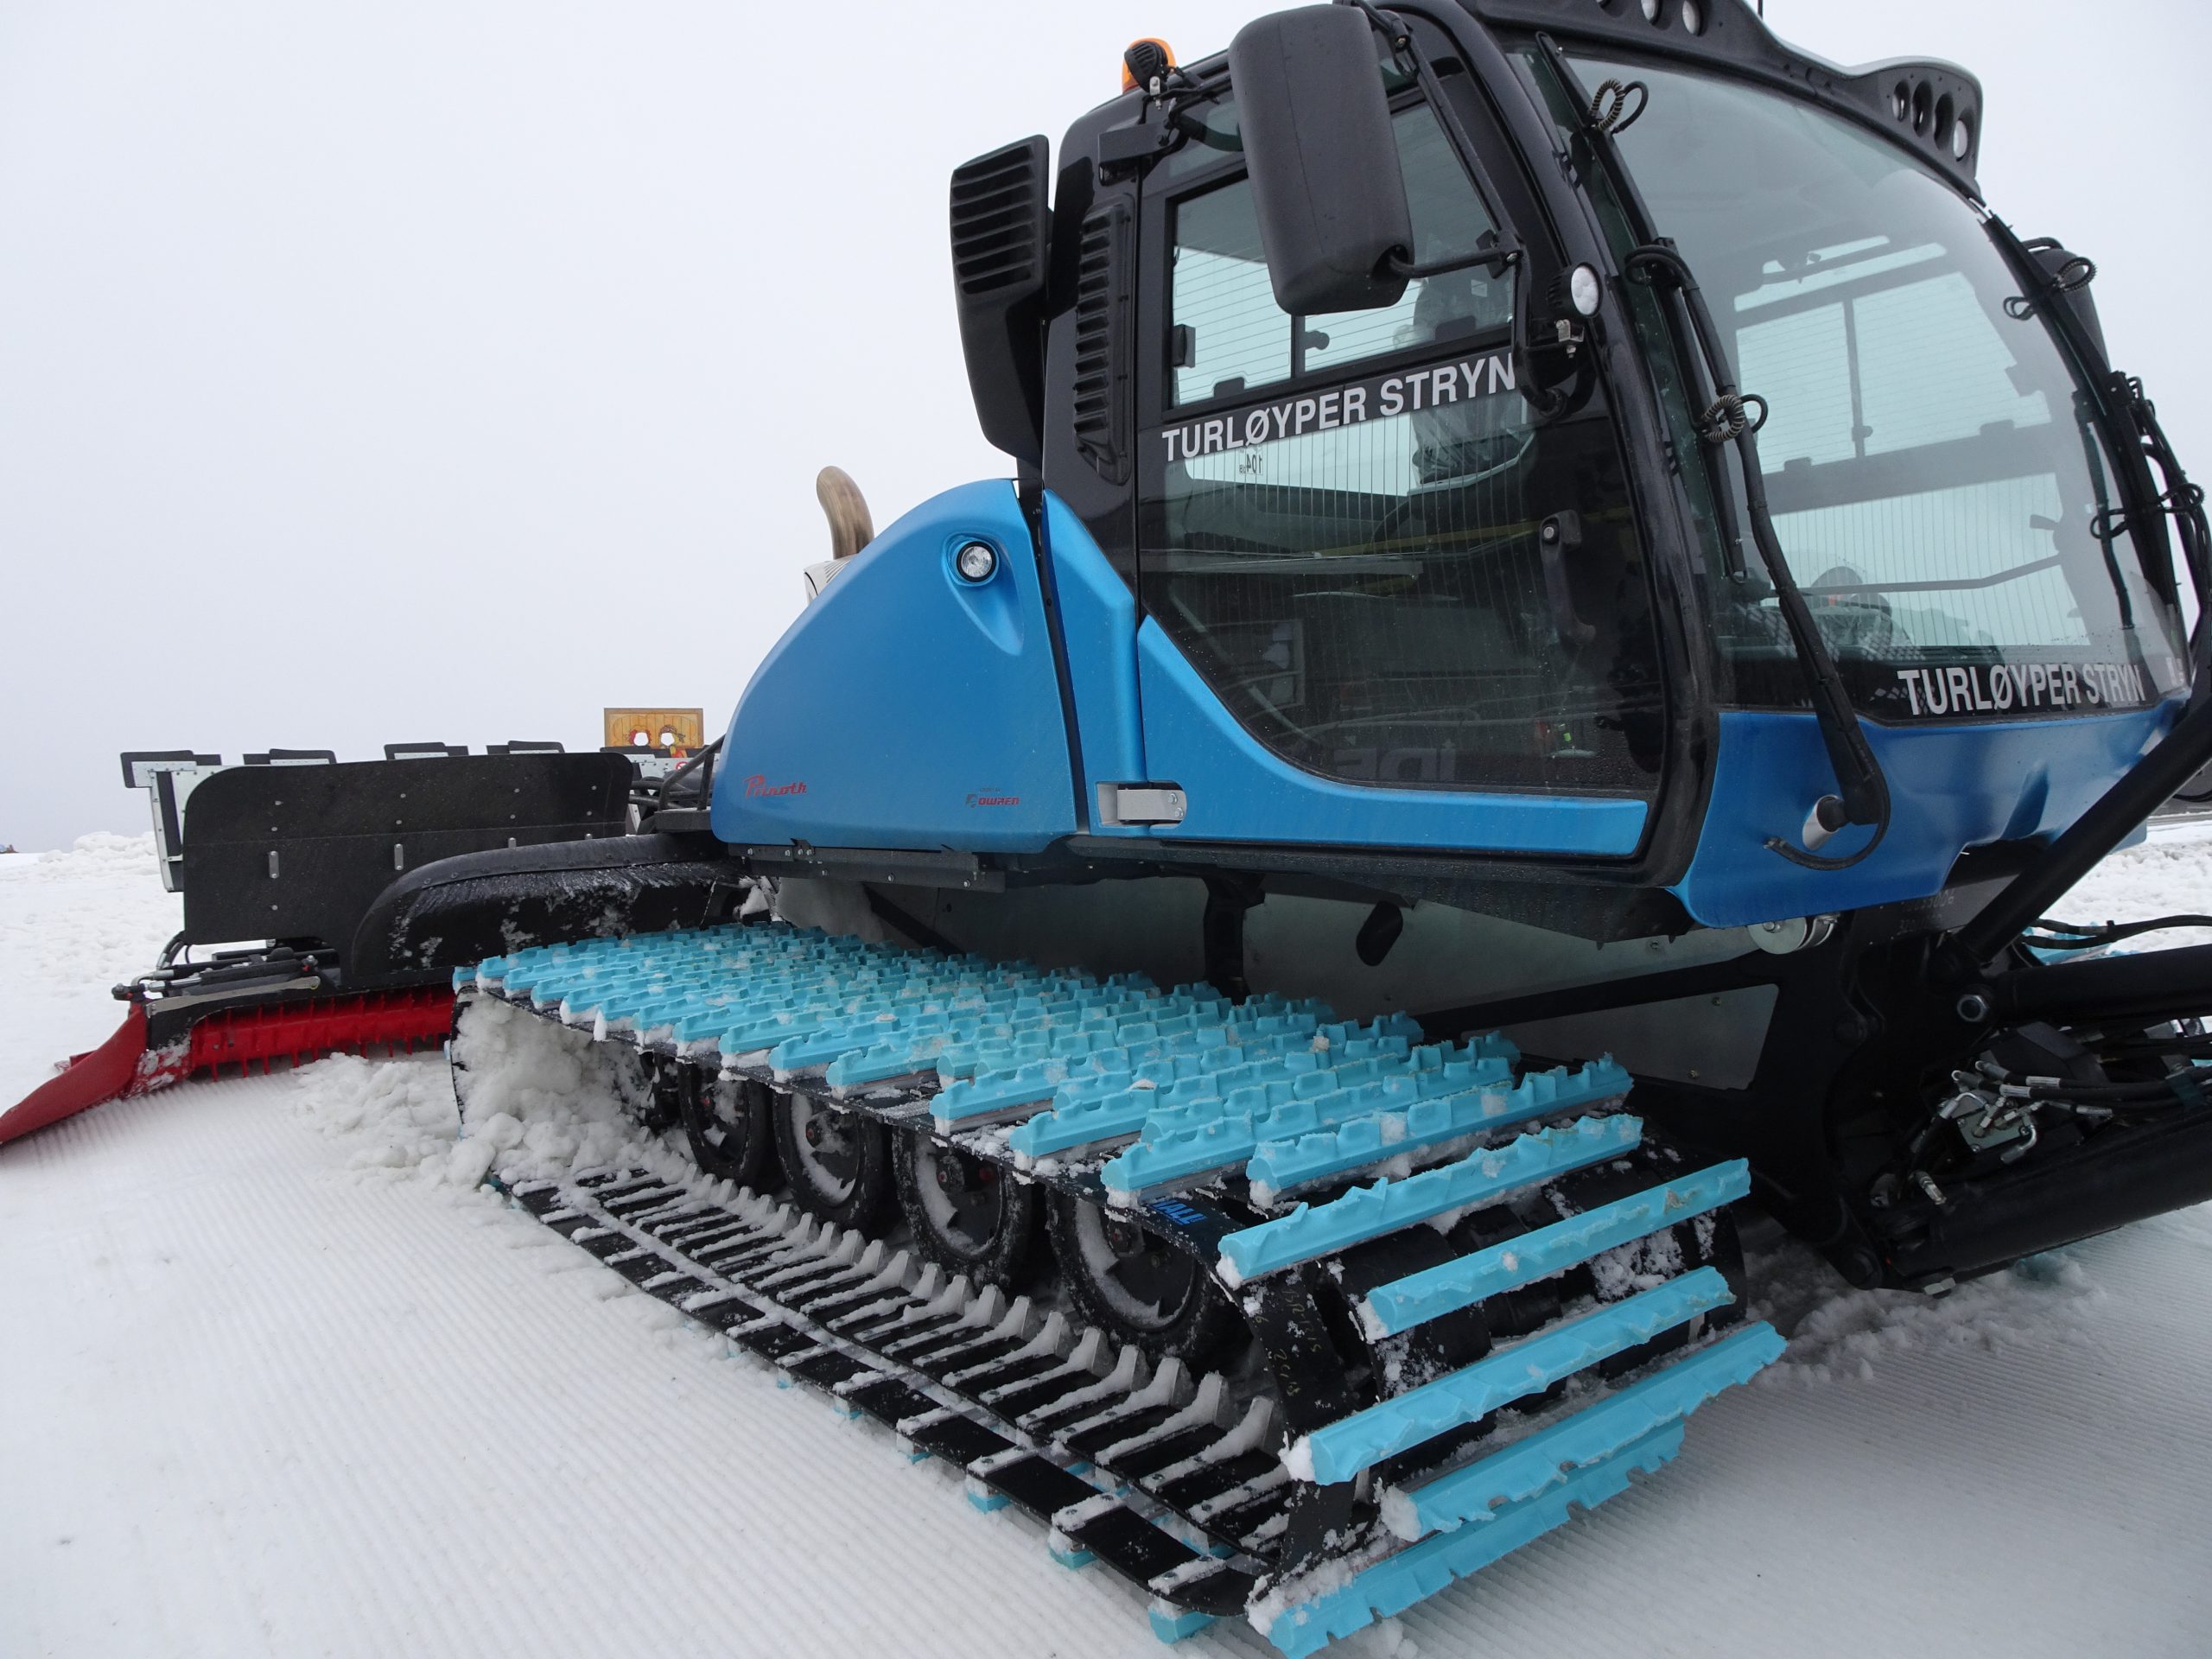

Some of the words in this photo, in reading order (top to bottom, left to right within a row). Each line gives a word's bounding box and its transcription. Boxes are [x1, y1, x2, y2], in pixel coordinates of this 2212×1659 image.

[1162, 387, 1366, 461] TURLØYPER
[1380, 353, 1516, 416] STRYN
[1897, 664, 2081, 715] TURLØYPER
[2082, 663, 2146, 704] STRYN
[743, 774, 807, 798] Prinoth
